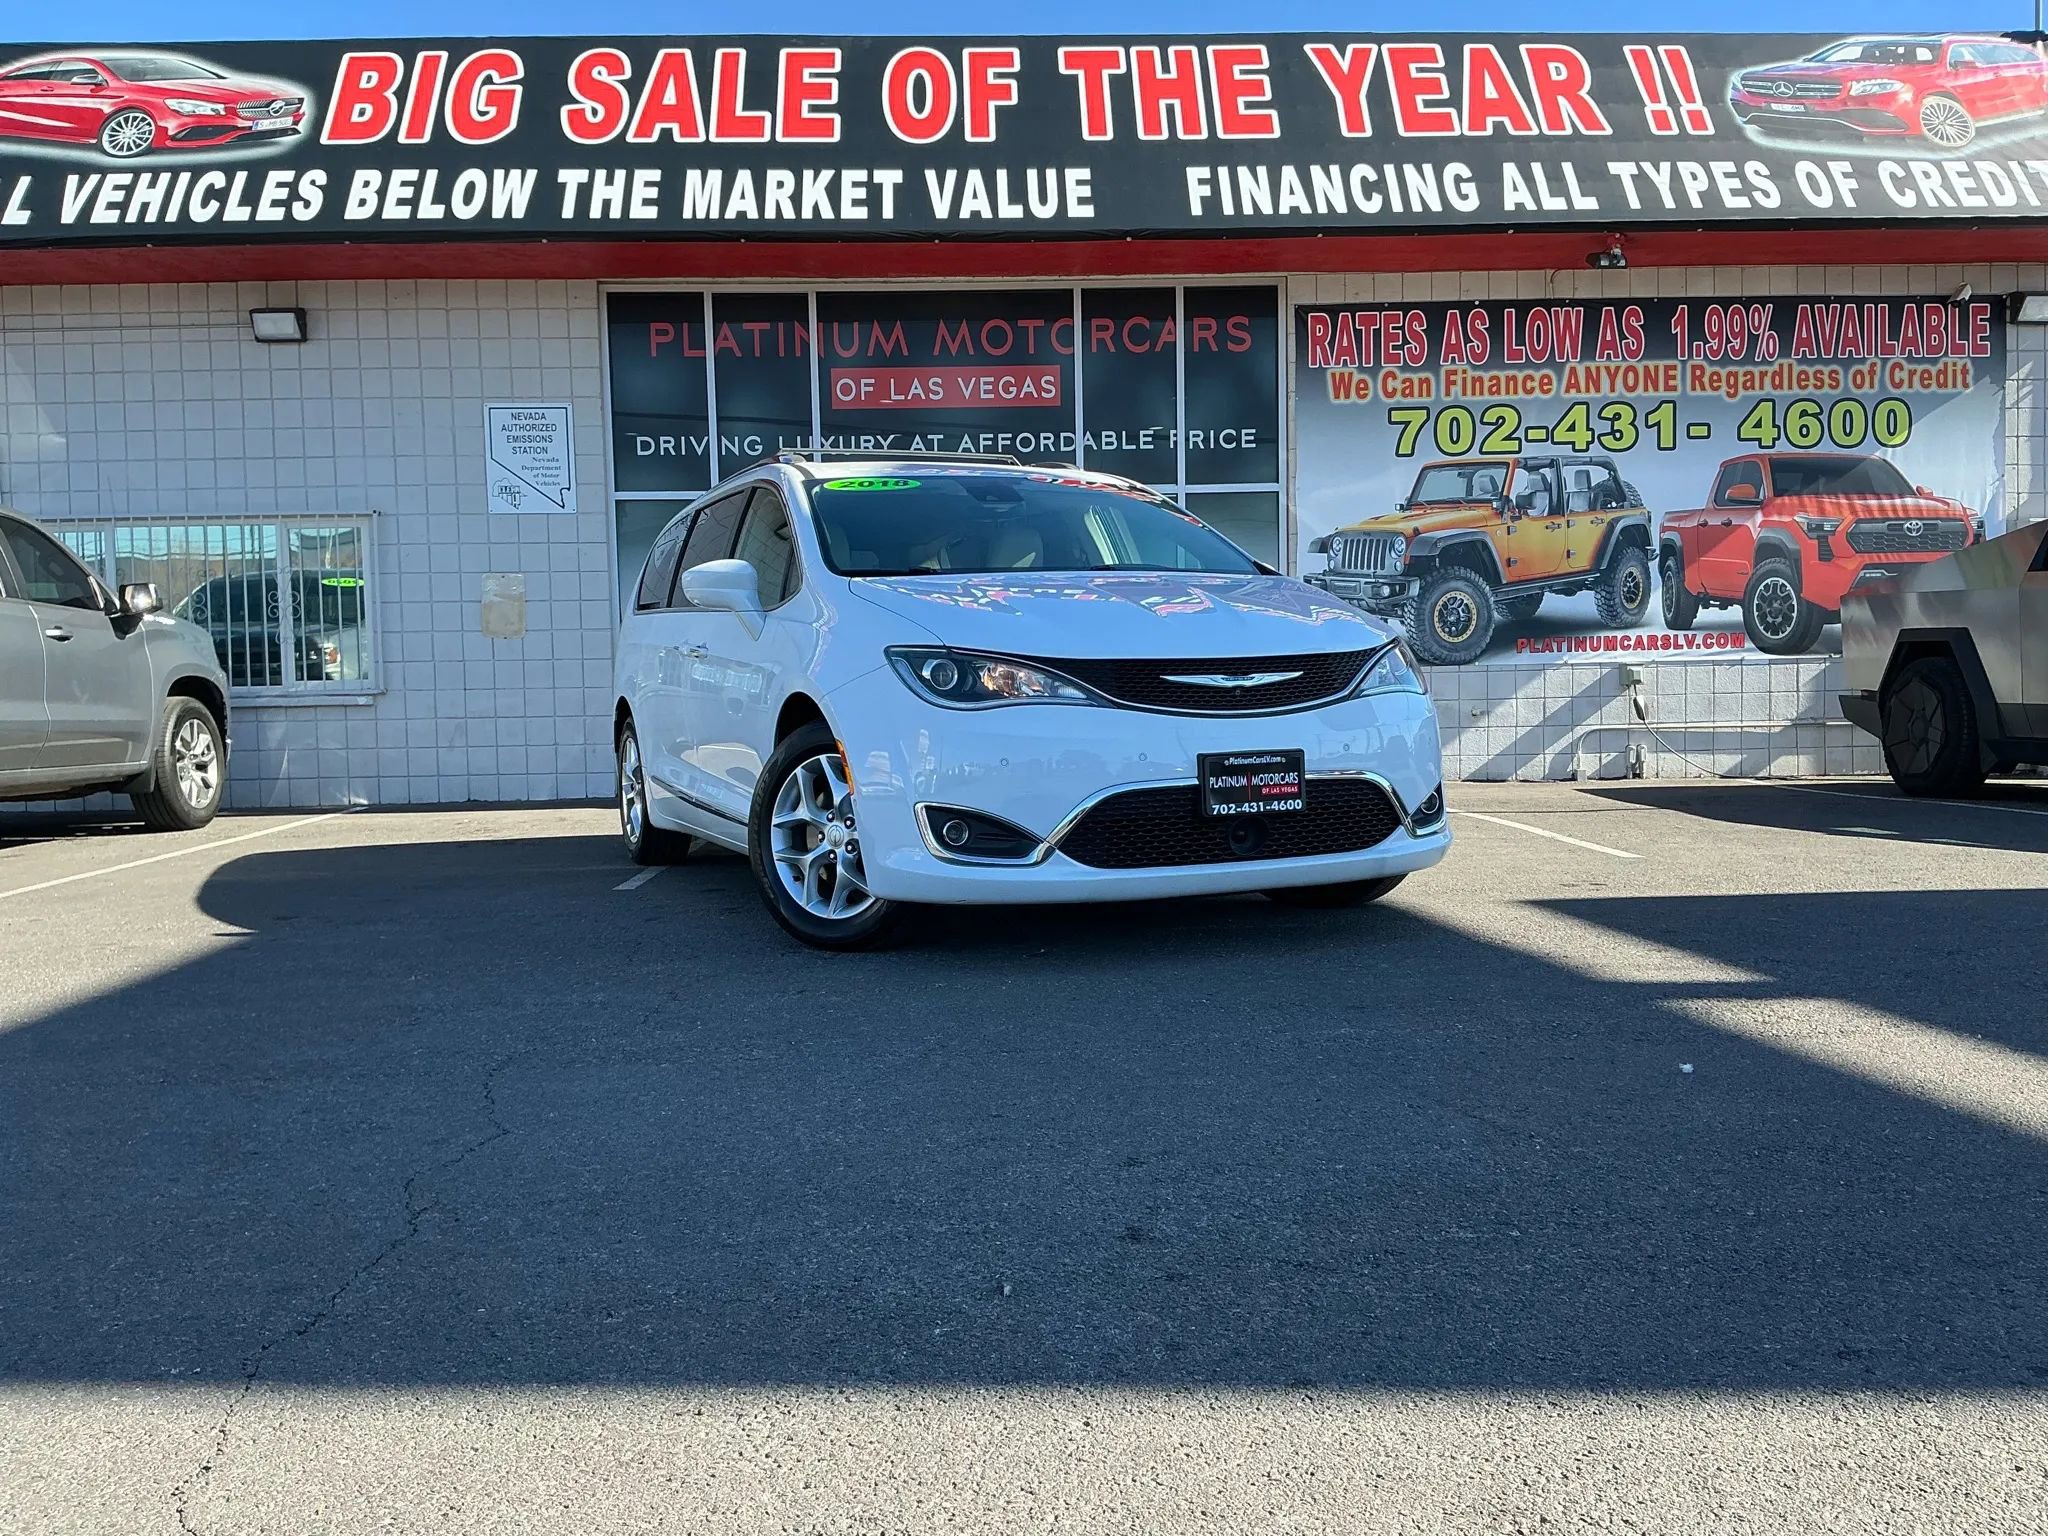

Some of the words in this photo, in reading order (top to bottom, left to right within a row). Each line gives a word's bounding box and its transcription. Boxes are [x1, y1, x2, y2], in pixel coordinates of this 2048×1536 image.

[319, 48, 525, 145] BIG
[560, 47, 842, 145] SALE
[881, 46, 1021, 144] OF
[1057, 45, 1281, 141] THE
[1303, 43, 1613, 138] YEAR
[60, 169, 327, 224] VEHICLES
[344, 168, 538, 220] BELOW
[557, 169, 662, 219] THE
[682, 169, 903, 219] MARKET
[925, 168, 1095, 219] VALUE
[1186, 162, 1480, 216] FINANCING
[1502, 161, 1600, 211] ALL
[1607, 160, 1782, 210] TYPES
[1795, 160, 1860, 209] OF
[649, 319, 909, 358] PLATINUM
[933, 315, 1252, 357] MOTORCARS
[1308, 310, 1428, 368] RATES
[1440, 308, 1490, 365] AS
[1504, 307, 1584, 364] LOW
[1596, 306, 1645, 362] AS
[1671, 304, 1779, 362] 1.99%
[1792, 303, 1990, 358] AVAILABLE
[836, 378, 876, 401] OF
[889, 377, 944, 401] LAS
[957, 375, 1057, 400] VEGAS
[1330, 371, 1370, 399] We
[1381, 370, 1432, 398] Can
[1444, 368, 1553, 396] Finance
[1564, 364, 1678, 393] ANYONE
[1690, 362, 1841, 399] Regardless
[1852, 361, 1877, 389] of
[1889, 361, 1970, 389] Credit
[501, 424, 557, 432] AUTHORIZED
[511, 412, 547, 421] NEVADA
[506, 435, 553, 444] EMISSIONS
[511, 446, 548, 455] STATION
[636, 435, 764, 457] DRIVNG
[909, 433, 944, 452] AT
[957, 430, 1155, 453] AFFORDABLE
[838, 480, 910, 488] 2018
[1515, 632, 1746, 654] PLATINUMCARSLV.COM
[1209, 775, 1247, 788] PLATINUM
[1251, 772, 1298, 786] MOTORCARS
[1212, 800, 1303, 815] 702-431-4600
